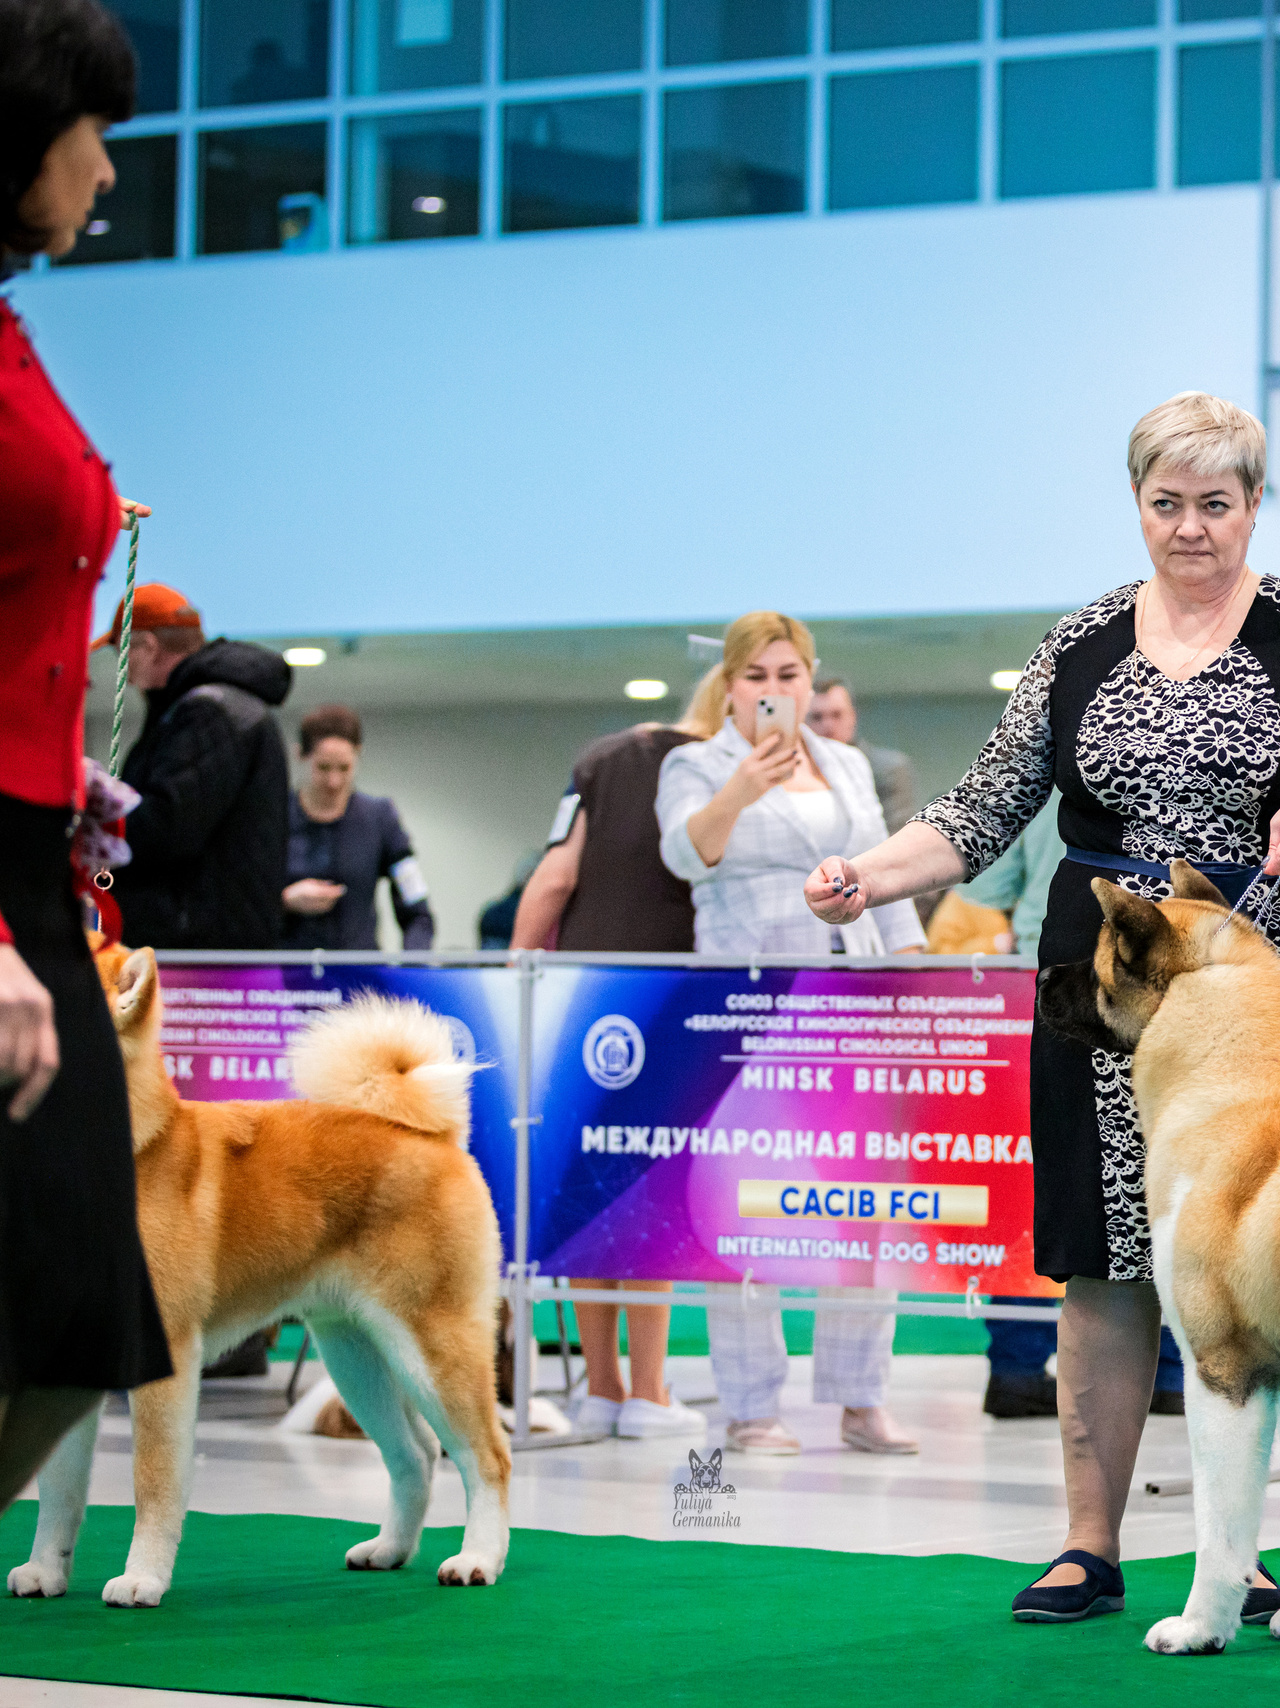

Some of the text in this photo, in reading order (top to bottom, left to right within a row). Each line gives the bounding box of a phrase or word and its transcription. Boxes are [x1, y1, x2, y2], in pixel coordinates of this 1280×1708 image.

[725, 994, 773, 1011] СОЮЗ
[896, 994, 1005, 1014] ОБЪЕДИНЕНИЙ
[933, 1018, 1033, 1036] ОБЪЕДИНЕНИ
[838, 1038, 937, 1055] CINOLOGICAL
[938, 1039, 988, 1056] UNION
[741, 1066, 986, 1095] MINSK BELARUS
[581, 1125, 1034, 1164] МЕЖДУНАРОДНАЯ ВЫСТАВКА
[780, 1186, 940, 1220] CACIB FCI
[717, 1235, 1006, 1267] INTERNATIONAL DOG SHOW
